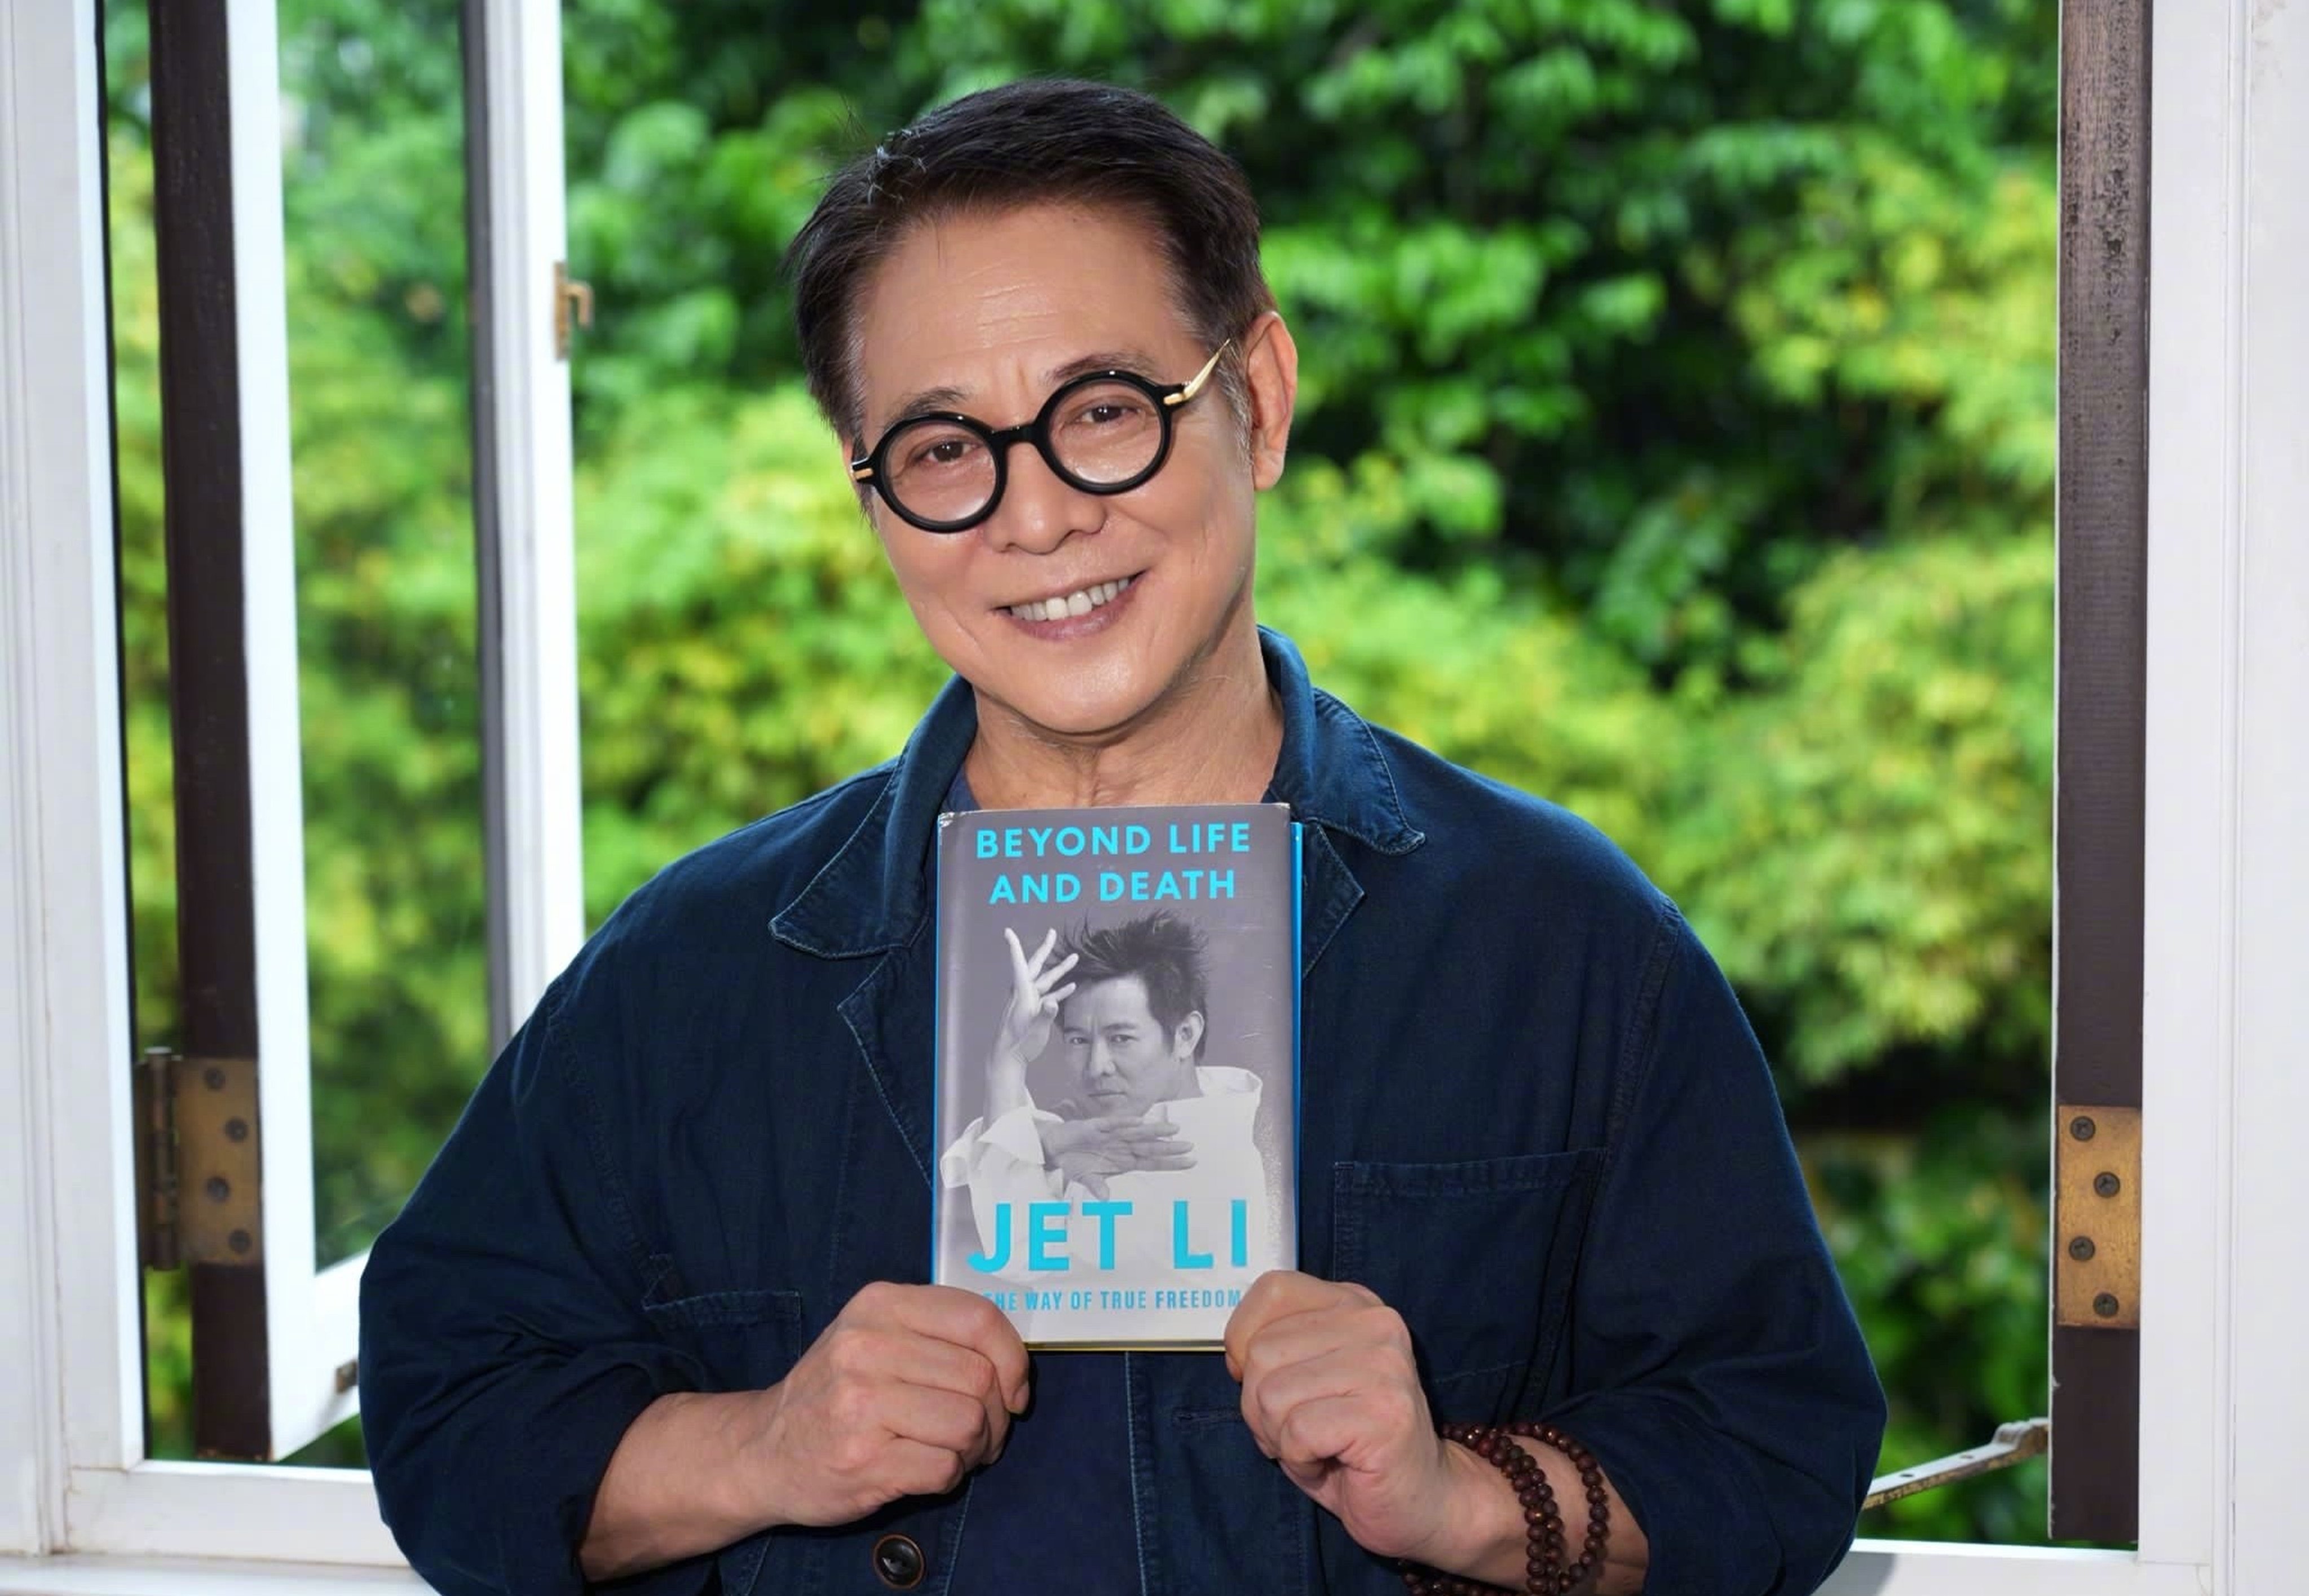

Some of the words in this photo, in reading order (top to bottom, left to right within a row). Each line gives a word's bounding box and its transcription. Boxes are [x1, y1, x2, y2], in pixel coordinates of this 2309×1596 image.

[975, 823, 1153, 860] BEYOND
[1169, 821, 1252, 855] LIFE
[988, 872, 1083, 905] AND
[1098, 868, 1237, 903] DEATH
[966, 1200, 1133, 1275] JET
[1172, 1199, 1248, 1270] LI
[1025, 1290, 1063, 1310] WAY
[1070, 1290, 1093, 1310] OF
[1100, 1290, 1146, 1309] TRUE
[1155, 1289, 1241, 1308] FREEDOM
